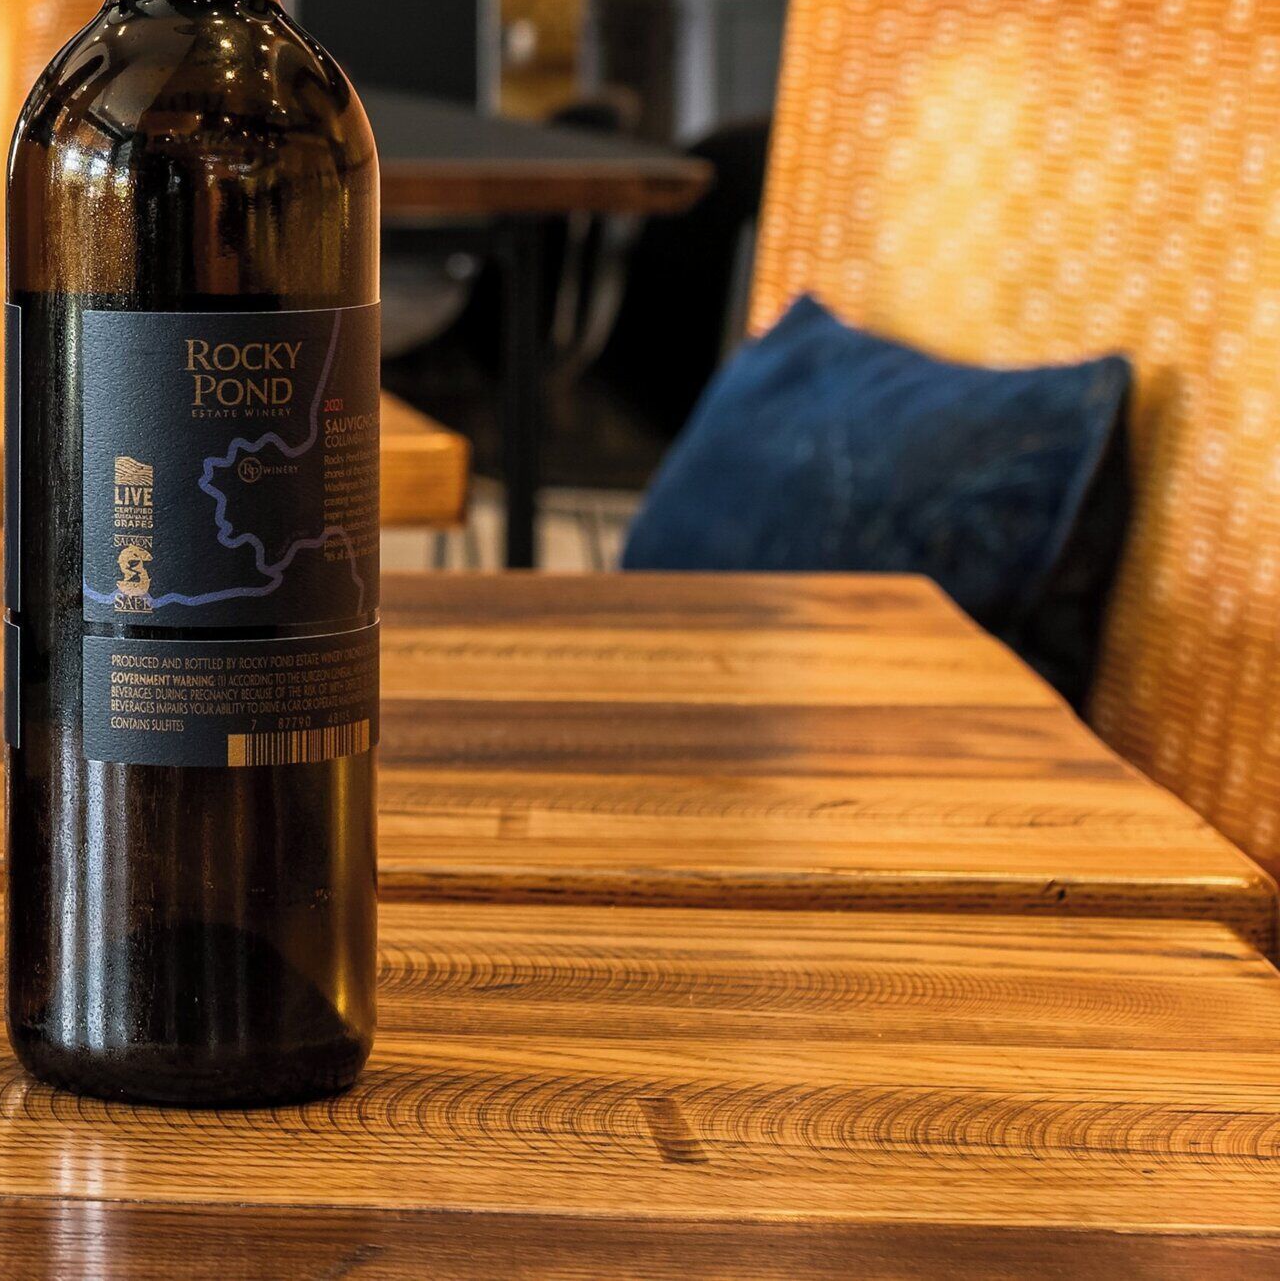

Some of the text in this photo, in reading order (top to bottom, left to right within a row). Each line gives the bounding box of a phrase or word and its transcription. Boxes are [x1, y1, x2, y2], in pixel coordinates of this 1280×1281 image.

[185, 339, 302, 370] ROCKY
[192, 374, 293, 406] POND
[191, 407, 292, 418] ESTATE WINERY
[114, 486, 153, 506] LIVE
[114, 520, 153, 529] GRAPES
[111, 654, 160, 669] PRODUCED
[161, 658, 182, 669] AND
[185, 658, 224, 670] BOTTLED
[226, 658, 238, 669] BY
[240, 657, 268, 670] ROCKY
[111, 671, 171, 686] GOVERNMENT
[228, 674, 273, 687] ACCORDING
[111, 685, 152, 700] BEVERAGES
[155, 688, 188, 701] DURING
[111, 699, 155, 714] BEVERAGES
[156, 702, 188, 715] IMPAIRS
[190, 702, 214, 715] YOUR
[247, 702, 259, 715] TO
[111, 716, 185, 732] CONTAINS SULFITES
